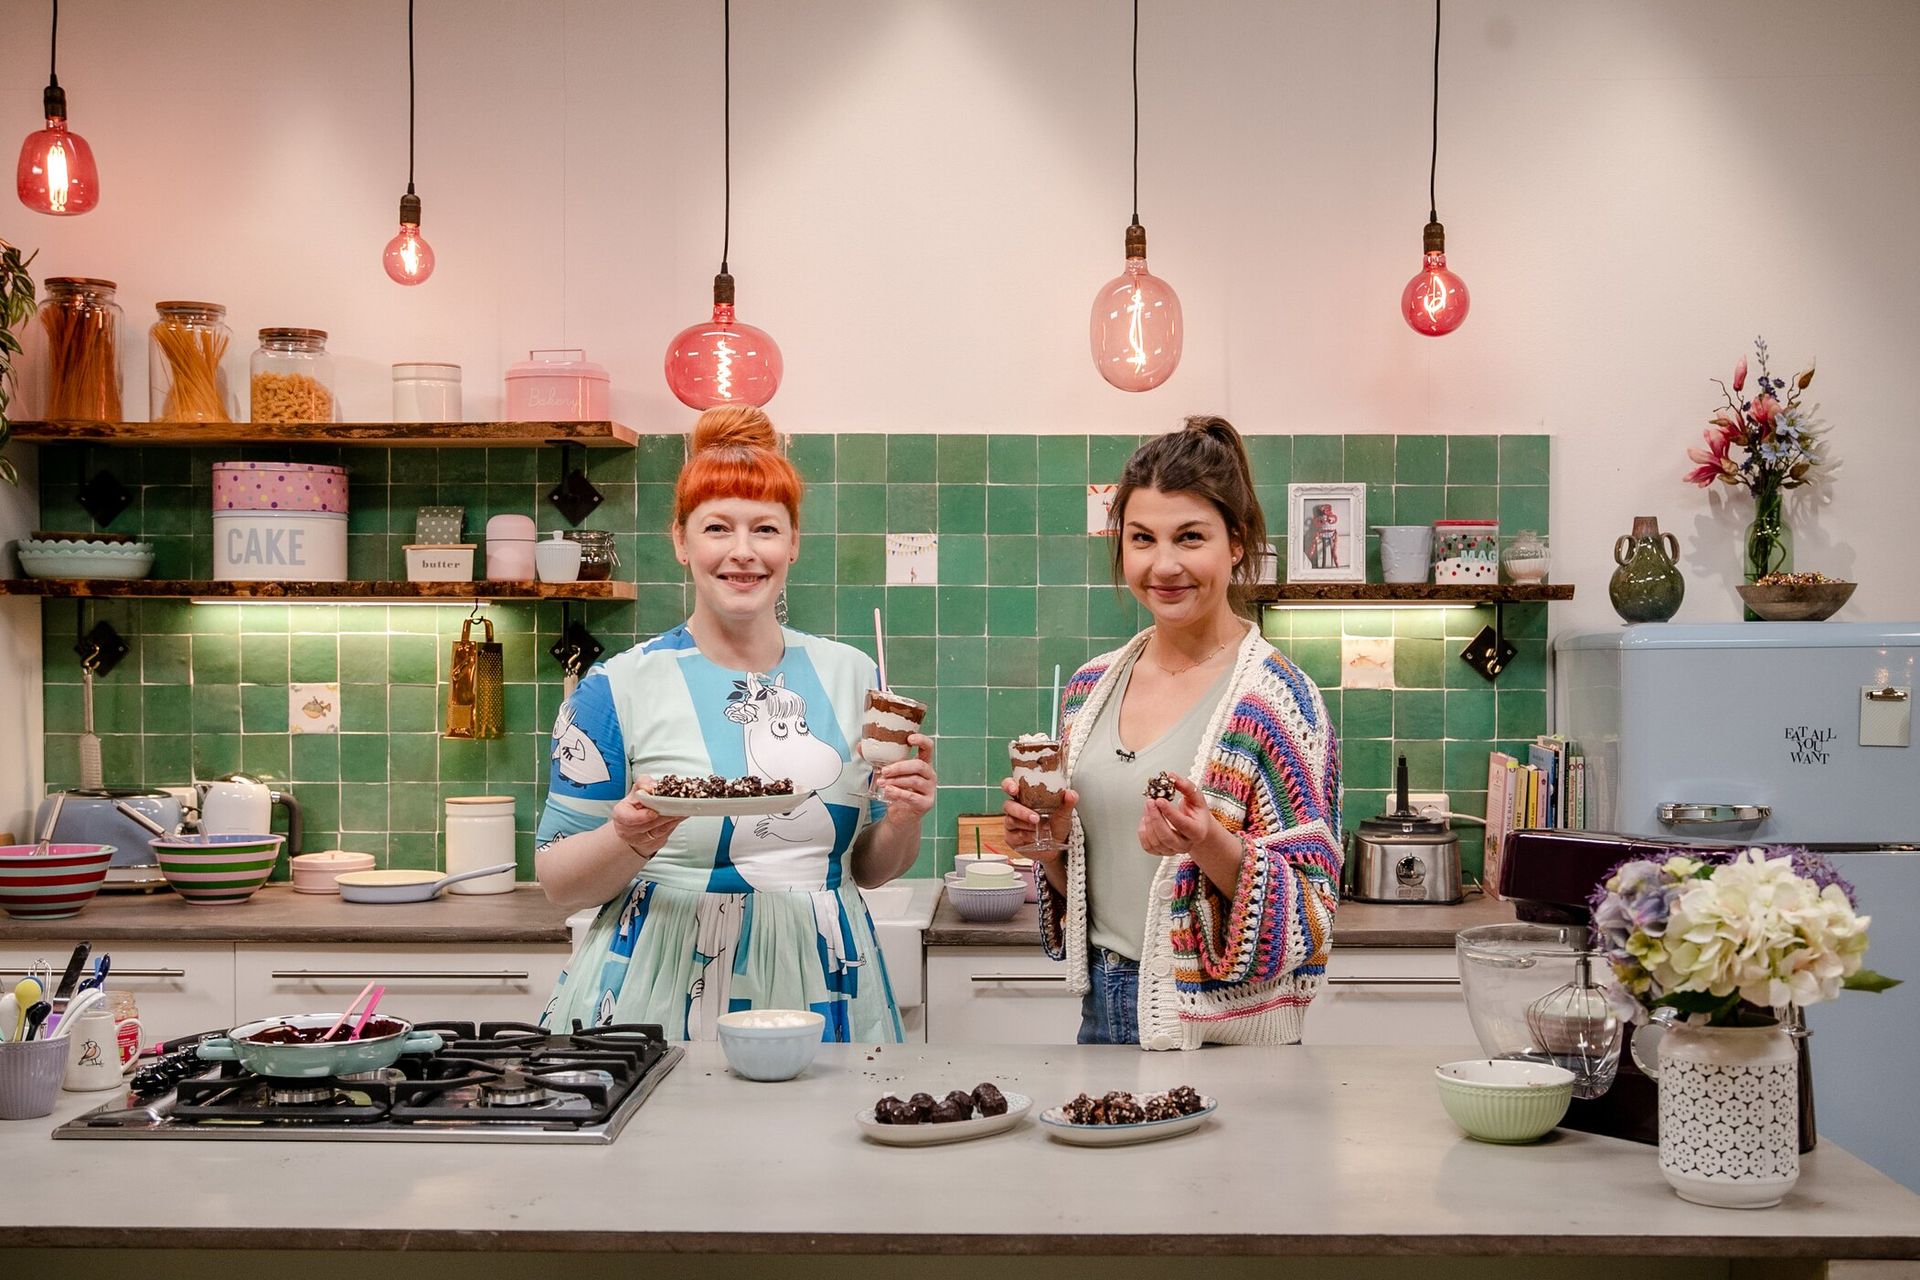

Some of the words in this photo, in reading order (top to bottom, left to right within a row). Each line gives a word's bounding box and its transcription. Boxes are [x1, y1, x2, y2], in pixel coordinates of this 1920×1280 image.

[528, 386, 578, 414] Bakery
[227, 527, 306, 566] CAKE
[422, 560, 460, 569] butter
[1784, 726, 1808, 741] EAT
[1811, 727, 1837, 742] ALL
[1797, 738, 1823, 753] YOU
[1790, 751, 1830, 764] WANT
